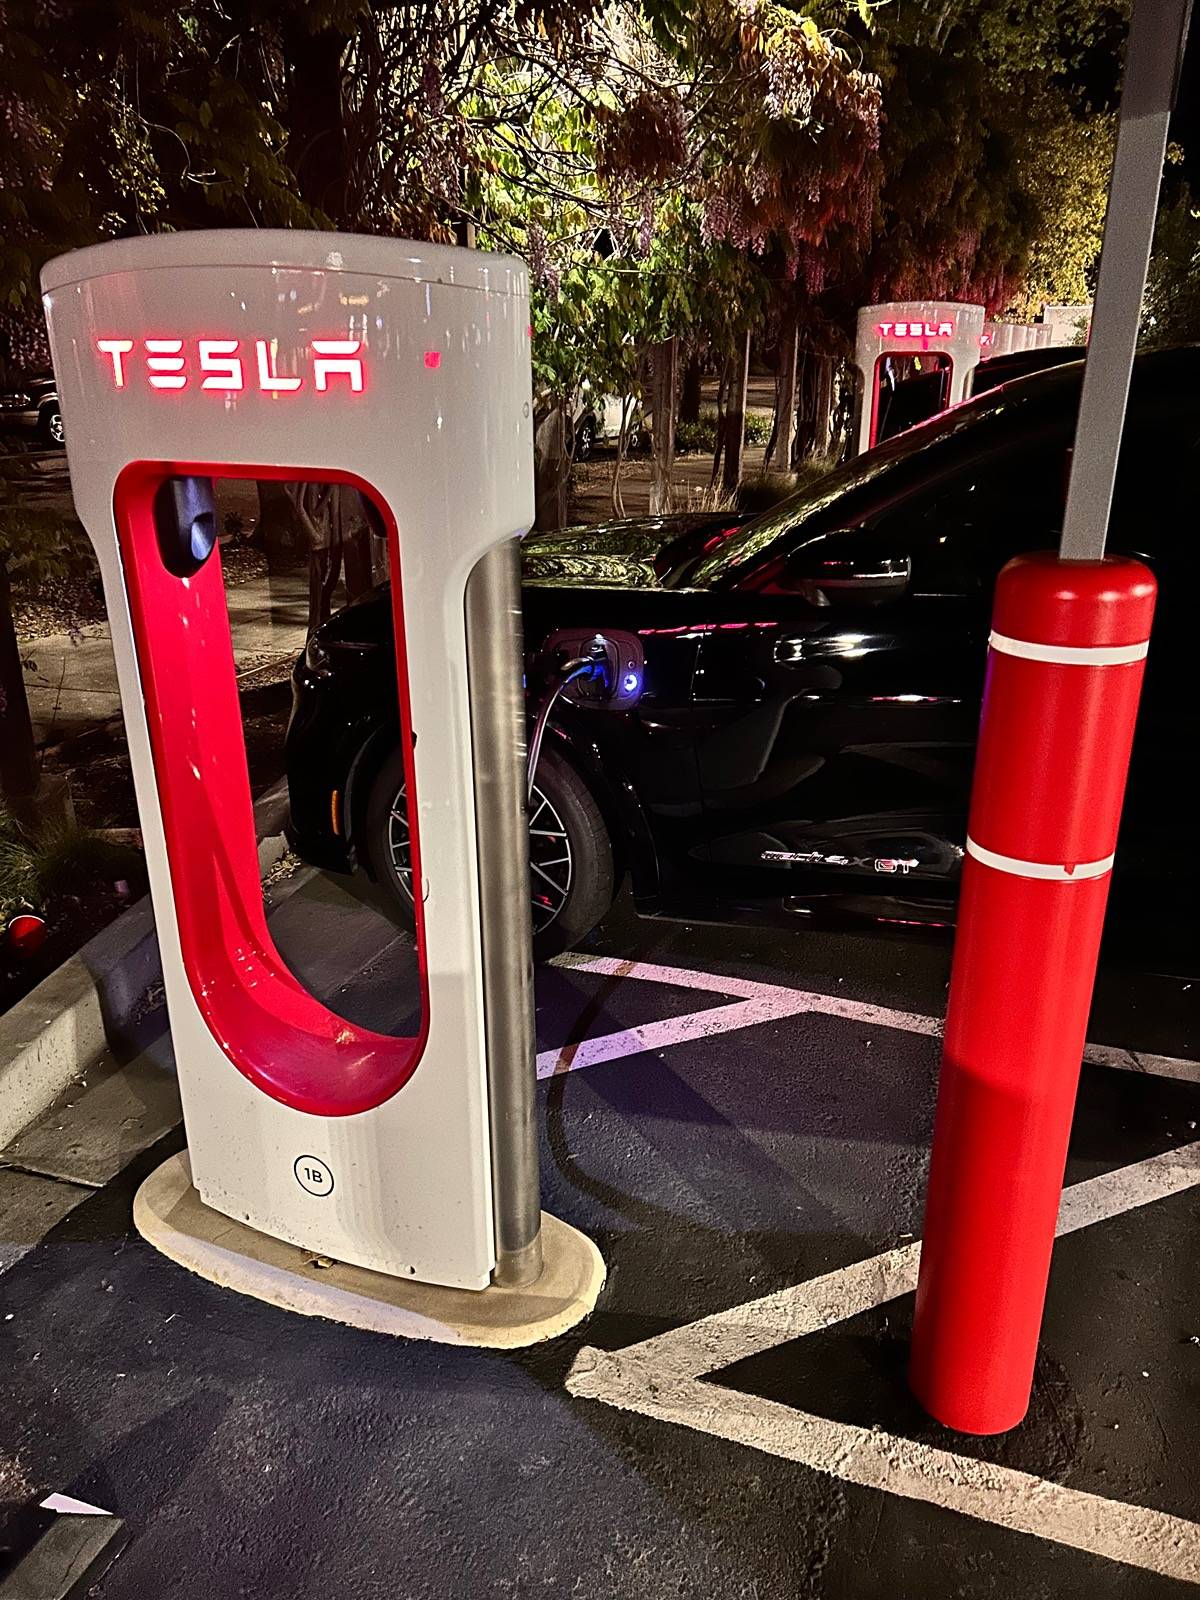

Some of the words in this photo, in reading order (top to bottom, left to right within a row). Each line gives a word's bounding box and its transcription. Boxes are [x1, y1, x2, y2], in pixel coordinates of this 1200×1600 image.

[879, 322, 953, 337] TESLA
[96, 339, 364, 392] TESLA
[303, 1167, 323, 1183] 1B
